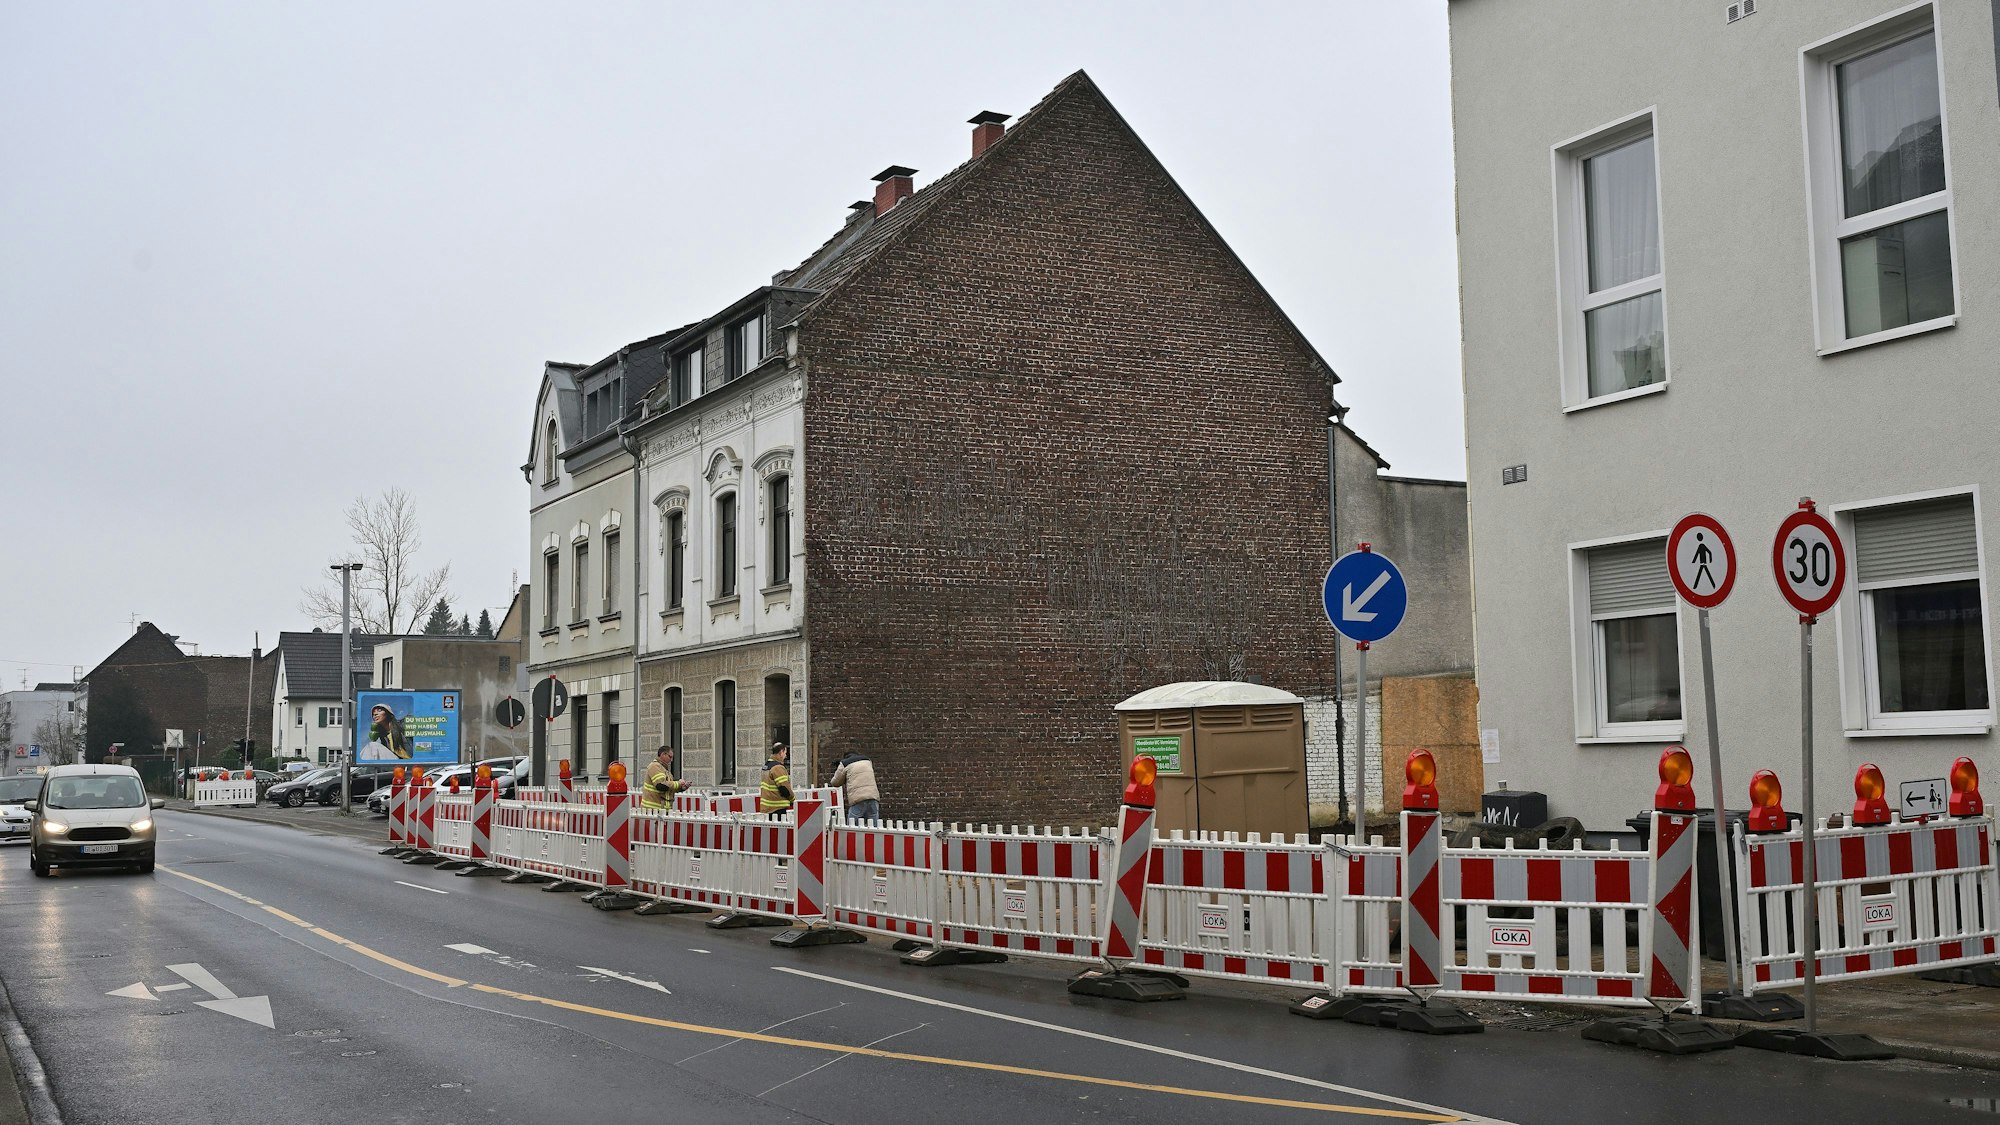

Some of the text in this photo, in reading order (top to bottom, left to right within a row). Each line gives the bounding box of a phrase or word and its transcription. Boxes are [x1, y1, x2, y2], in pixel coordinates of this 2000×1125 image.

[1789, 538, 1830, 587] 30
[1867, 906, 1890, 919] LÖKA
[1495, 928, 1528, 943] LÖKA
